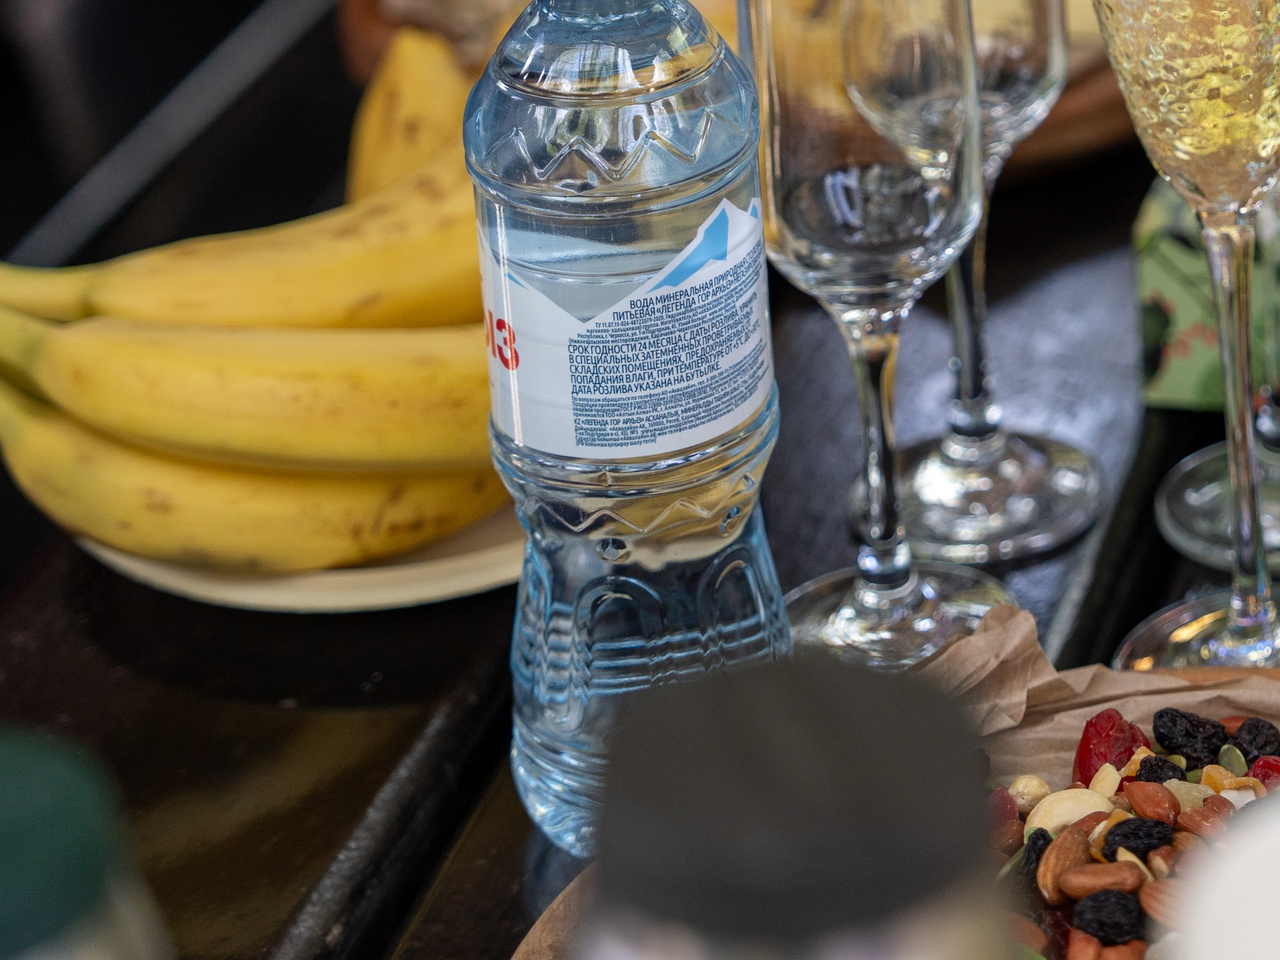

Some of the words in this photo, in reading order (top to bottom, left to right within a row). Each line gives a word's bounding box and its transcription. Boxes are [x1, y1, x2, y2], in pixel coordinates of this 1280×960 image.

[613, 307, 655, 321] ПИТЬЕВАЯ
[656, 296, 696, 316] «ЛЕГЕНДА
[698, 290, 710, 304] ГОР
[712, 278, 733, 298] АРХЫЗ»
[630, 297, 654, 311] ВОДА
[656, 279, 713, 305] МИНЕРАЛЬНАЯ
[714, 256, 745, 287] ПРИРОДНАЯ
[568, 345, 589, 354] СРОК
[591, 343, 637, 355] ГОДНОСТИ
[638, 342, 647, 351] 24
[649, 334, 683, 350] МЕСЯЦА
[684, 332, 688, 342] С
[689, 324, 710, 341] ДАТЫ
[569, 355, 574, 363] В
[575, 353, 640, 365] СПЕЦИАЛЬНЫХ
[641, 338, 701, 361] ЗАТЕМНЕННЫХ
[702, 305, 753, 345] ПРОВЕТРИВАЕМЫХ
[570, 365, 620, 375] СКЛАДСКИХ
[622, 354, 685, 374] ПОМЕЩЕНИЯХ,
[686, 323, 745, 361] ПРЕДОХРАНЯЕМЫХ
[571, 375, 624, 385] ПОПАДАНИЯ
[626, 371, 656, 383] ВЛАГИ,
[657, 367, 674, 378] ПРИ
[675, 348, 724, 374] ТЕМПЕРАТУРЕ
[725, 343, 732, 355] ОТ
[571, 385, 592, 395] ДАТА
[593, 384, 633, 394] РОЗЛИВА
[633, 377, 672, 392] УКАЗАНА
[674, 374, 685, 385] НА
[686, 359, 722, 382] БУТЫЛКЕ.
